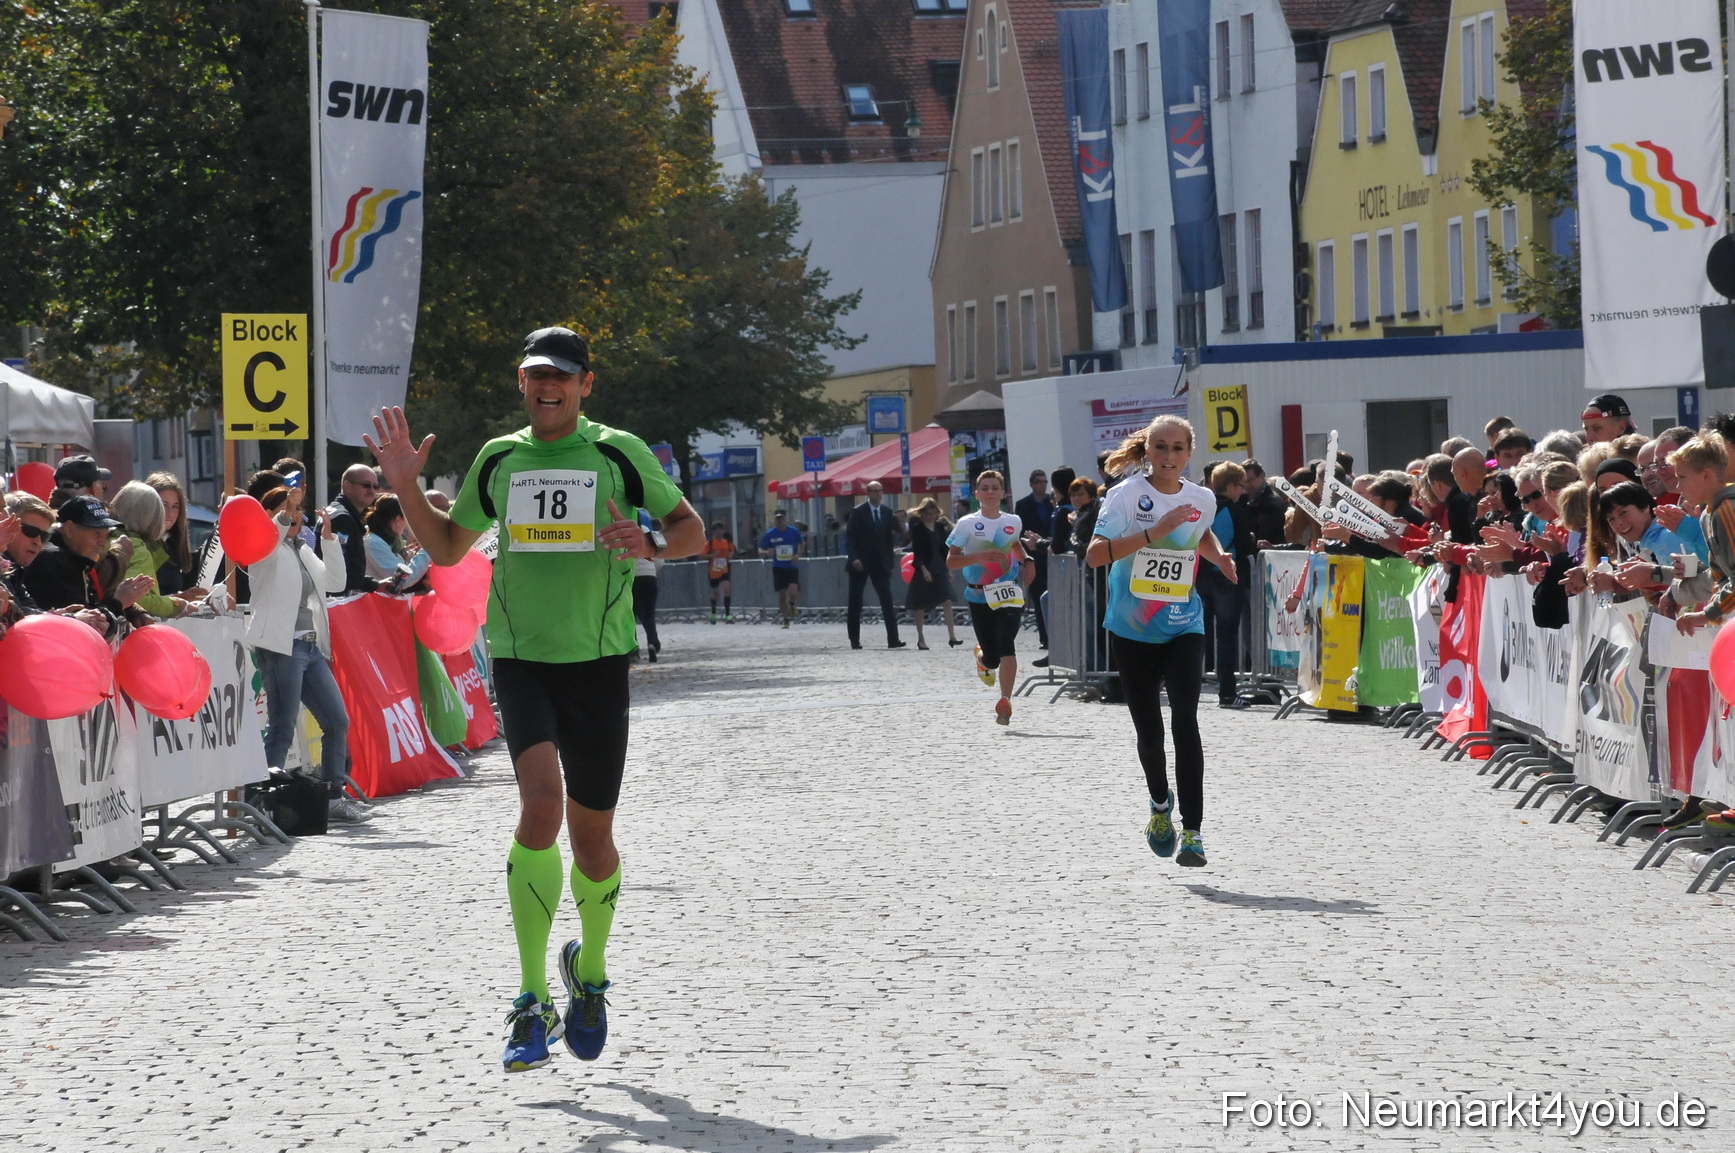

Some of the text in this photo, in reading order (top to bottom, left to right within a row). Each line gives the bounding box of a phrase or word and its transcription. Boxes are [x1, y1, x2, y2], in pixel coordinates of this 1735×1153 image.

[326, 80, 425, 125] swn
[1168, 85, 1208, 179] K&L
[1358, 184, 1389, 221] HOTEL
[232, 319, 298, 341] Block
[353, 363, 401, 376] neumarkt
[243, 351, 287, 413] C
[1110, 400, 1140, 408] DAHMIT
[1208, 388, 1243, 403] Block
[1216, 406, 1240, 439] D
[805, 460, 825, 470] TAXI
[539, 478, 581, 486] Neumarkt
[533, 489, 567, 520] 18
[1341, 491, 1399, 532] BMW Laufsport
[1336, 516, 1359, 531] BMW
[526, 527, 571, 540] Thomas
[1138, 550, 1158, 558] PARTL
[1144, 559, 1183, 581] 269
[993, 587, 1016, 602] 106
[1152, 584, 1171, 594] Sina
[1378, 637, 1417, 670] Willko
